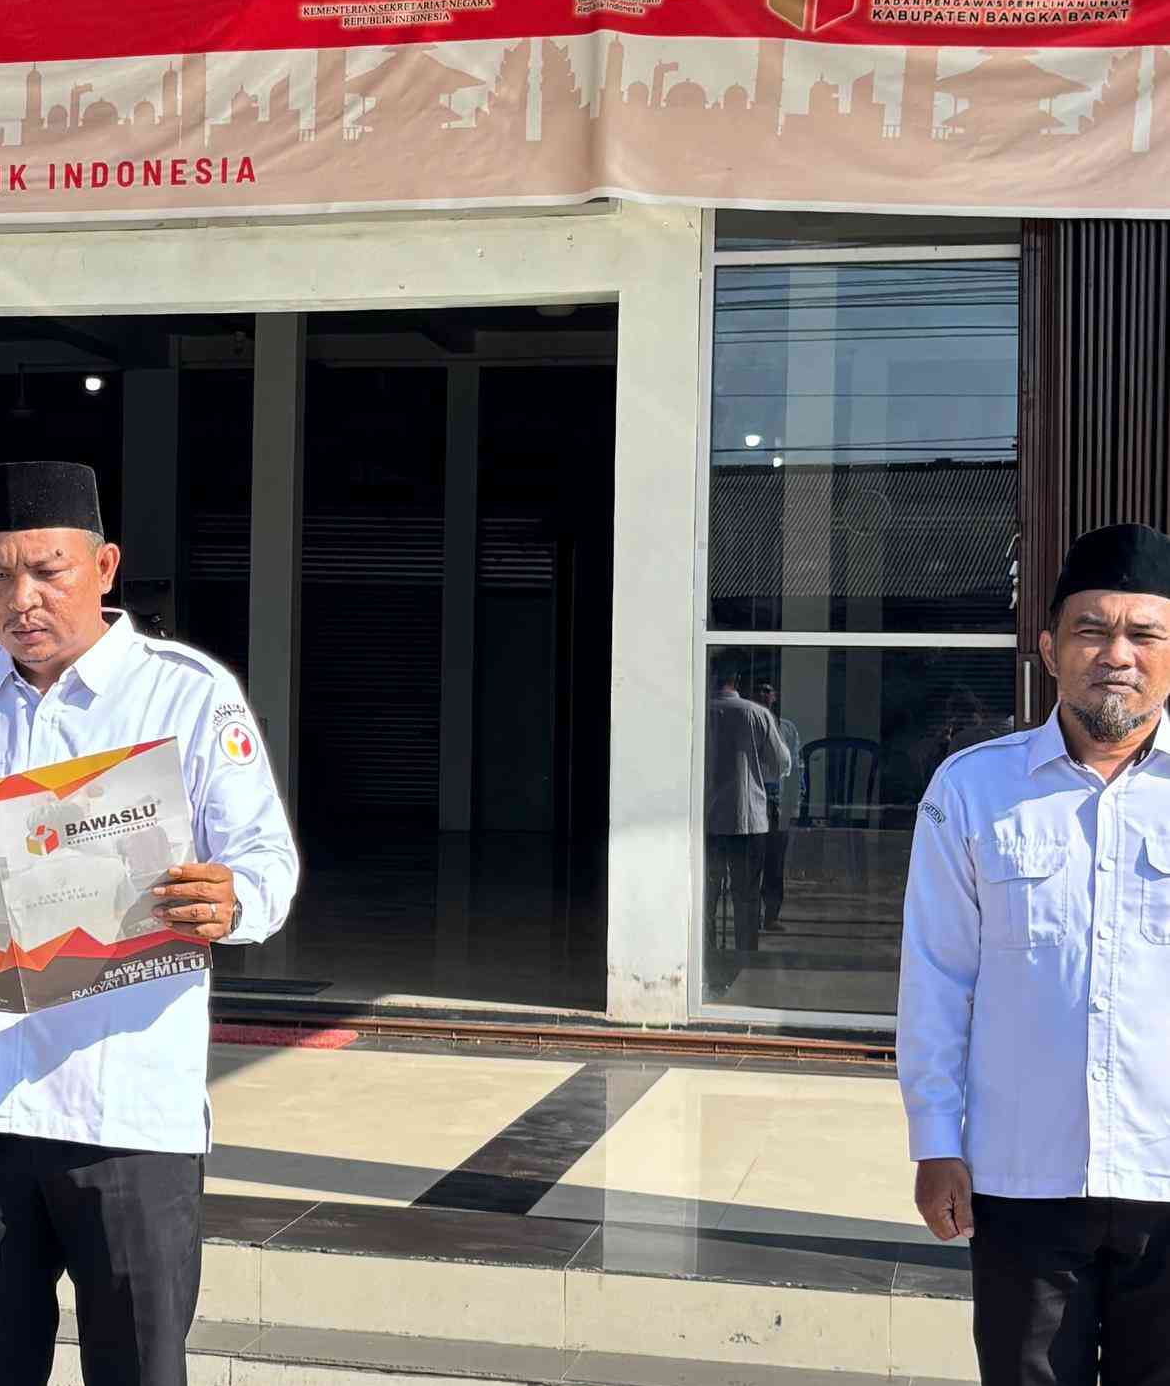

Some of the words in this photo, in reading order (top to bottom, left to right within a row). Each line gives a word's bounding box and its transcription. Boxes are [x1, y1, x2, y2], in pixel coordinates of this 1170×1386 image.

[303, 4, 376, 15] KEMENTERIAN
[378, 0, 447, 12] SEKRETARIAT
[1008, 0, 1085, 8] PEMILIHAN
[343, 15, 393, 26] REPUBLIK
[394, 13, 450, 24] INDONESIA
[872, 9, 980, 22] KABUPATEN
[986, 11, 1062, 23] BANGKA
[1068, 9, 1129, 22] BARAT
[49, 156, 257, 190] INDONESIA
[65, 803, 157, 836] BAWASLU
[104, 955, 173, 979] BAWASLU
[71, 979, 120, 999] RAKYAT
[128, 957, 205, 984] PEMILU
